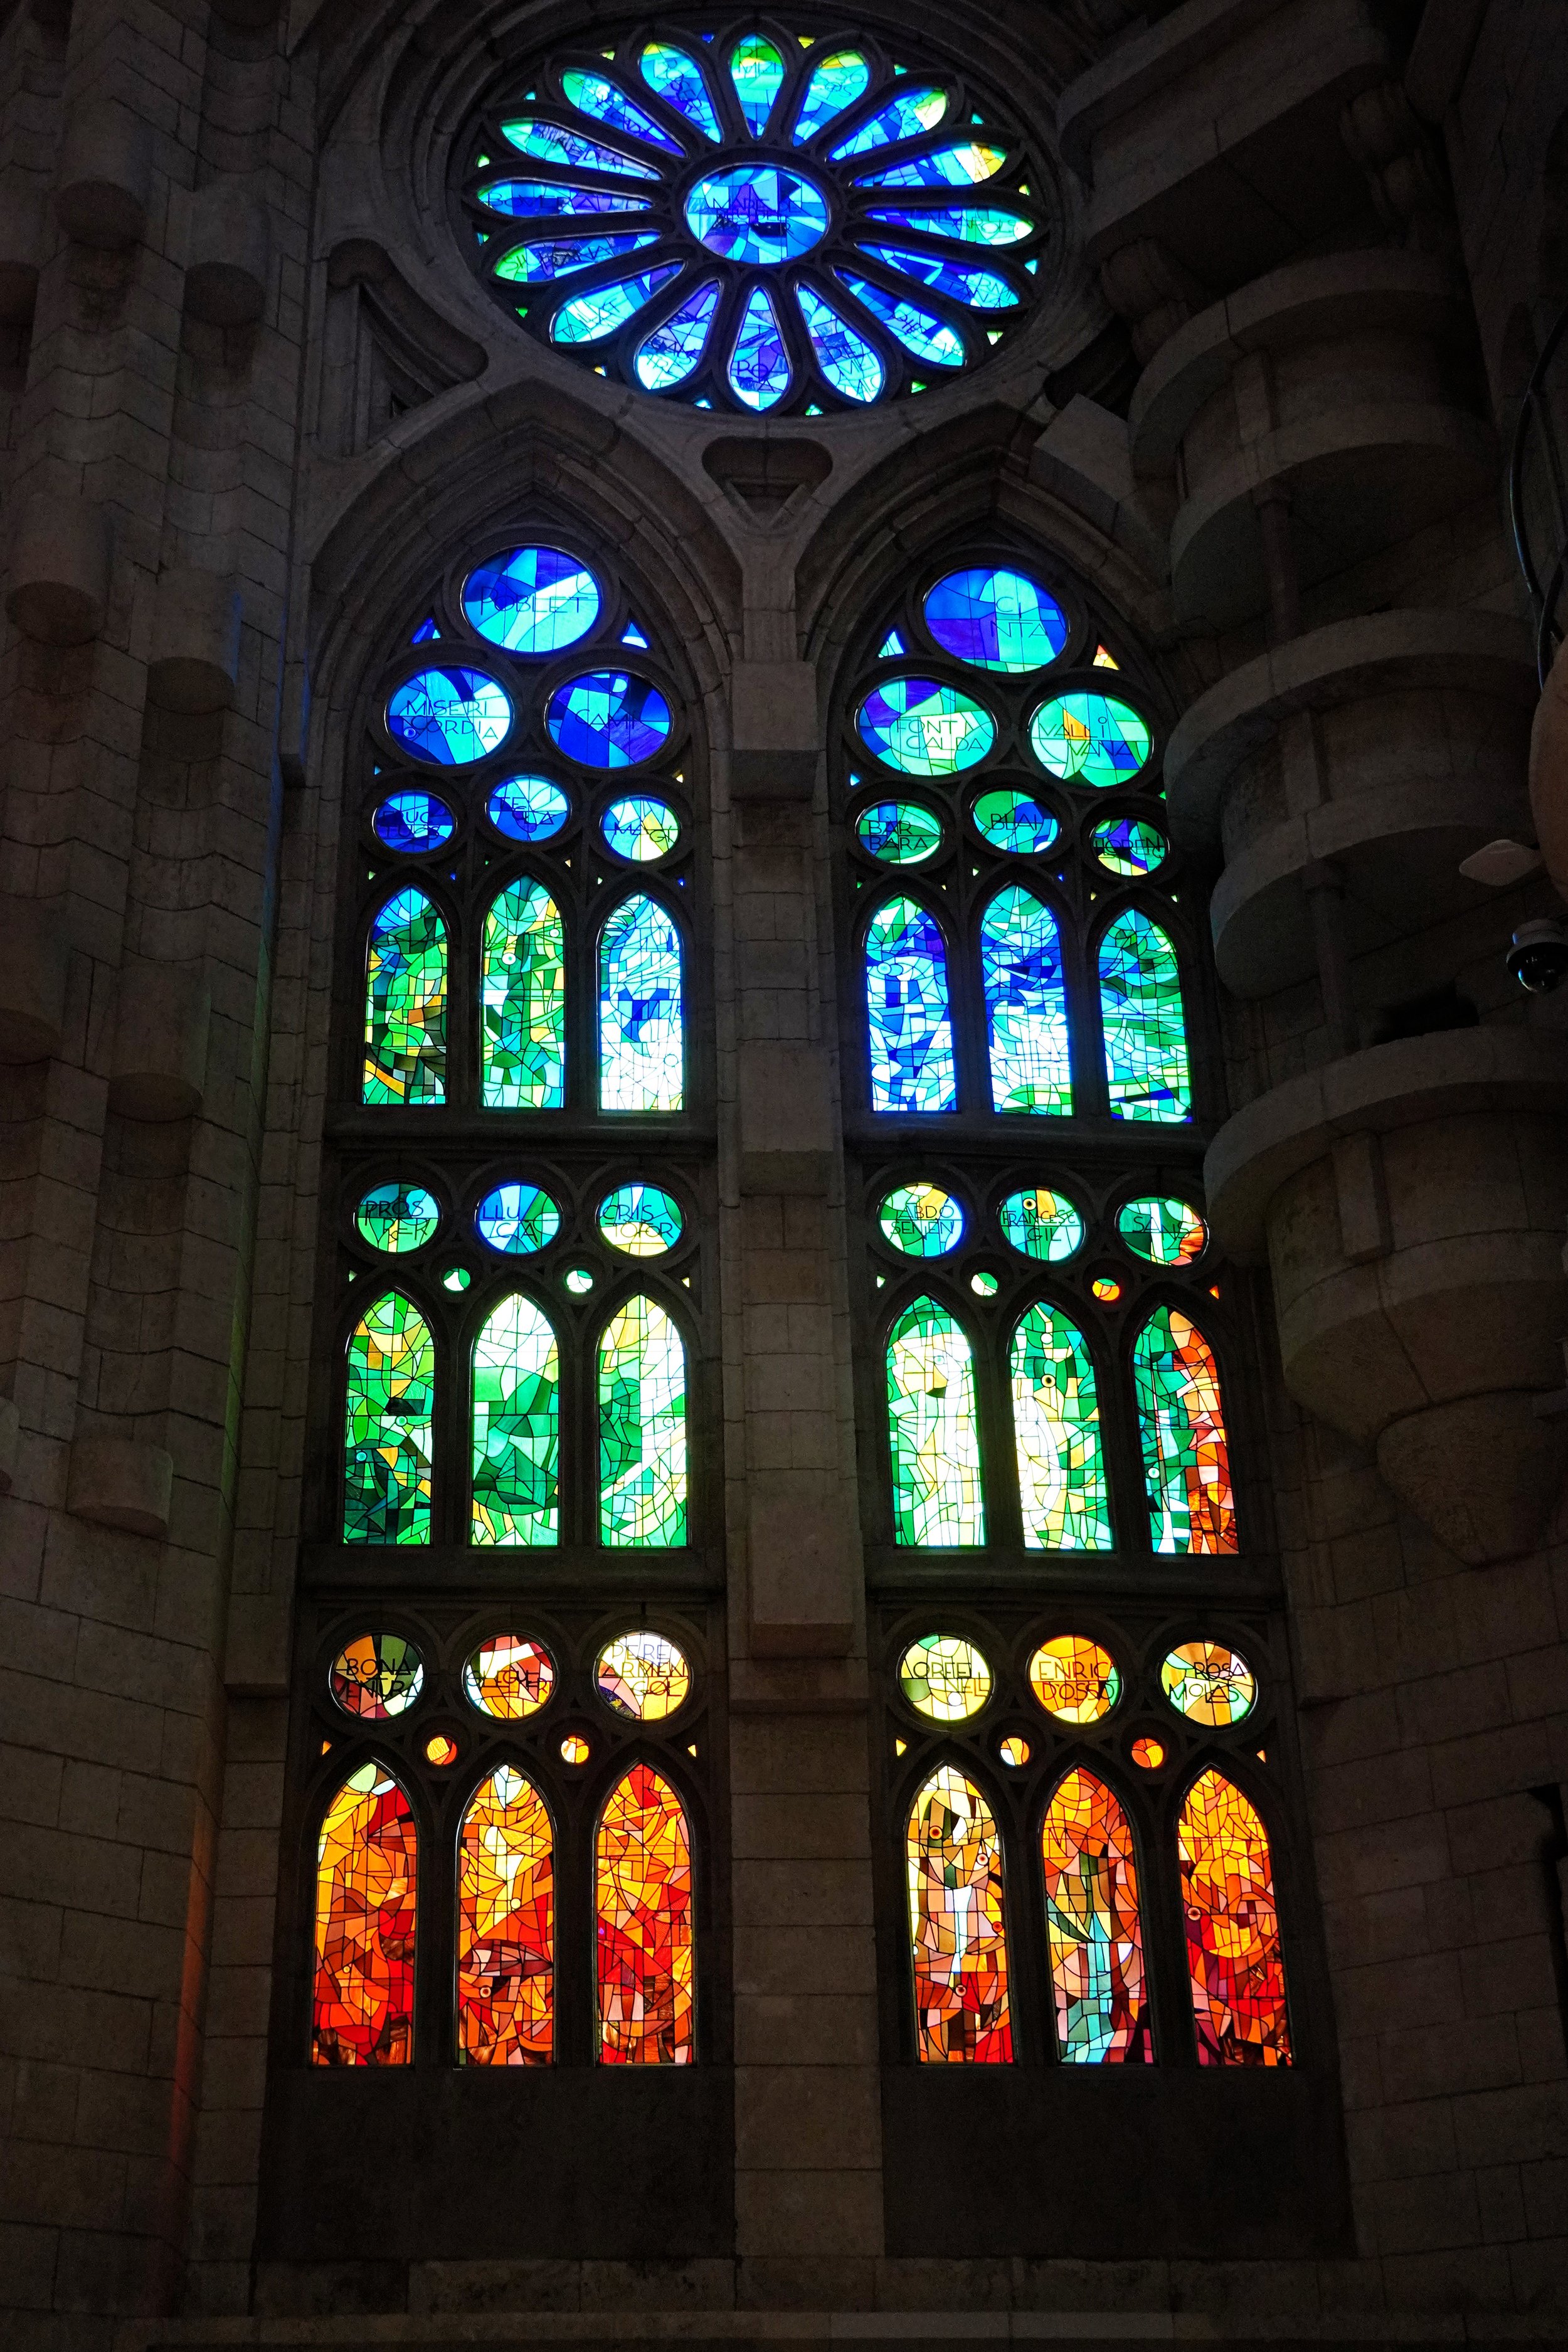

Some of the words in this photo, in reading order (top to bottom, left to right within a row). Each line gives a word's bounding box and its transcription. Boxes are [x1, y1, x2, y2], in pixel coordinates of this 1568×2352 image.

[481, 586, 588, 615] POBLET
[990, 620, 1047, 638] NTA
[406, 699, 487, 716] MISERI
[410, 716, 498, 740] CORDIA
[896, 719, 958, 733] FONT
[906, 736, 985, 753] CALDA
[990, 813, 1037, 830] BLAI
[869, 837, 928, 850] BARA
[365, 1200, 424, 1226] PROS
[482, 1205, 519, 1219] LLU
[602, 1204, 654, 1222] CRIS
[898, 1205, 954, 1219] ABDO
[1002, 1209, 1075, 1227] FRANCESC
[605, 1222, 674, 1239] TOFOR
[1027, 1227, 1061, 1241] GIL
[612, 1644, 670, 1660] PERE
[346, 1657, 411, 1676] BONA
[601, 1661, 685, 1678] ARMEN
[1039, 1661, 1109, 1680] ENRIC
[1194, 1662, 1247, 1680] ROSA
[632, 1680, 682, 1697] GOL
[1168, 1683, 1239, 1703] MOLAS
